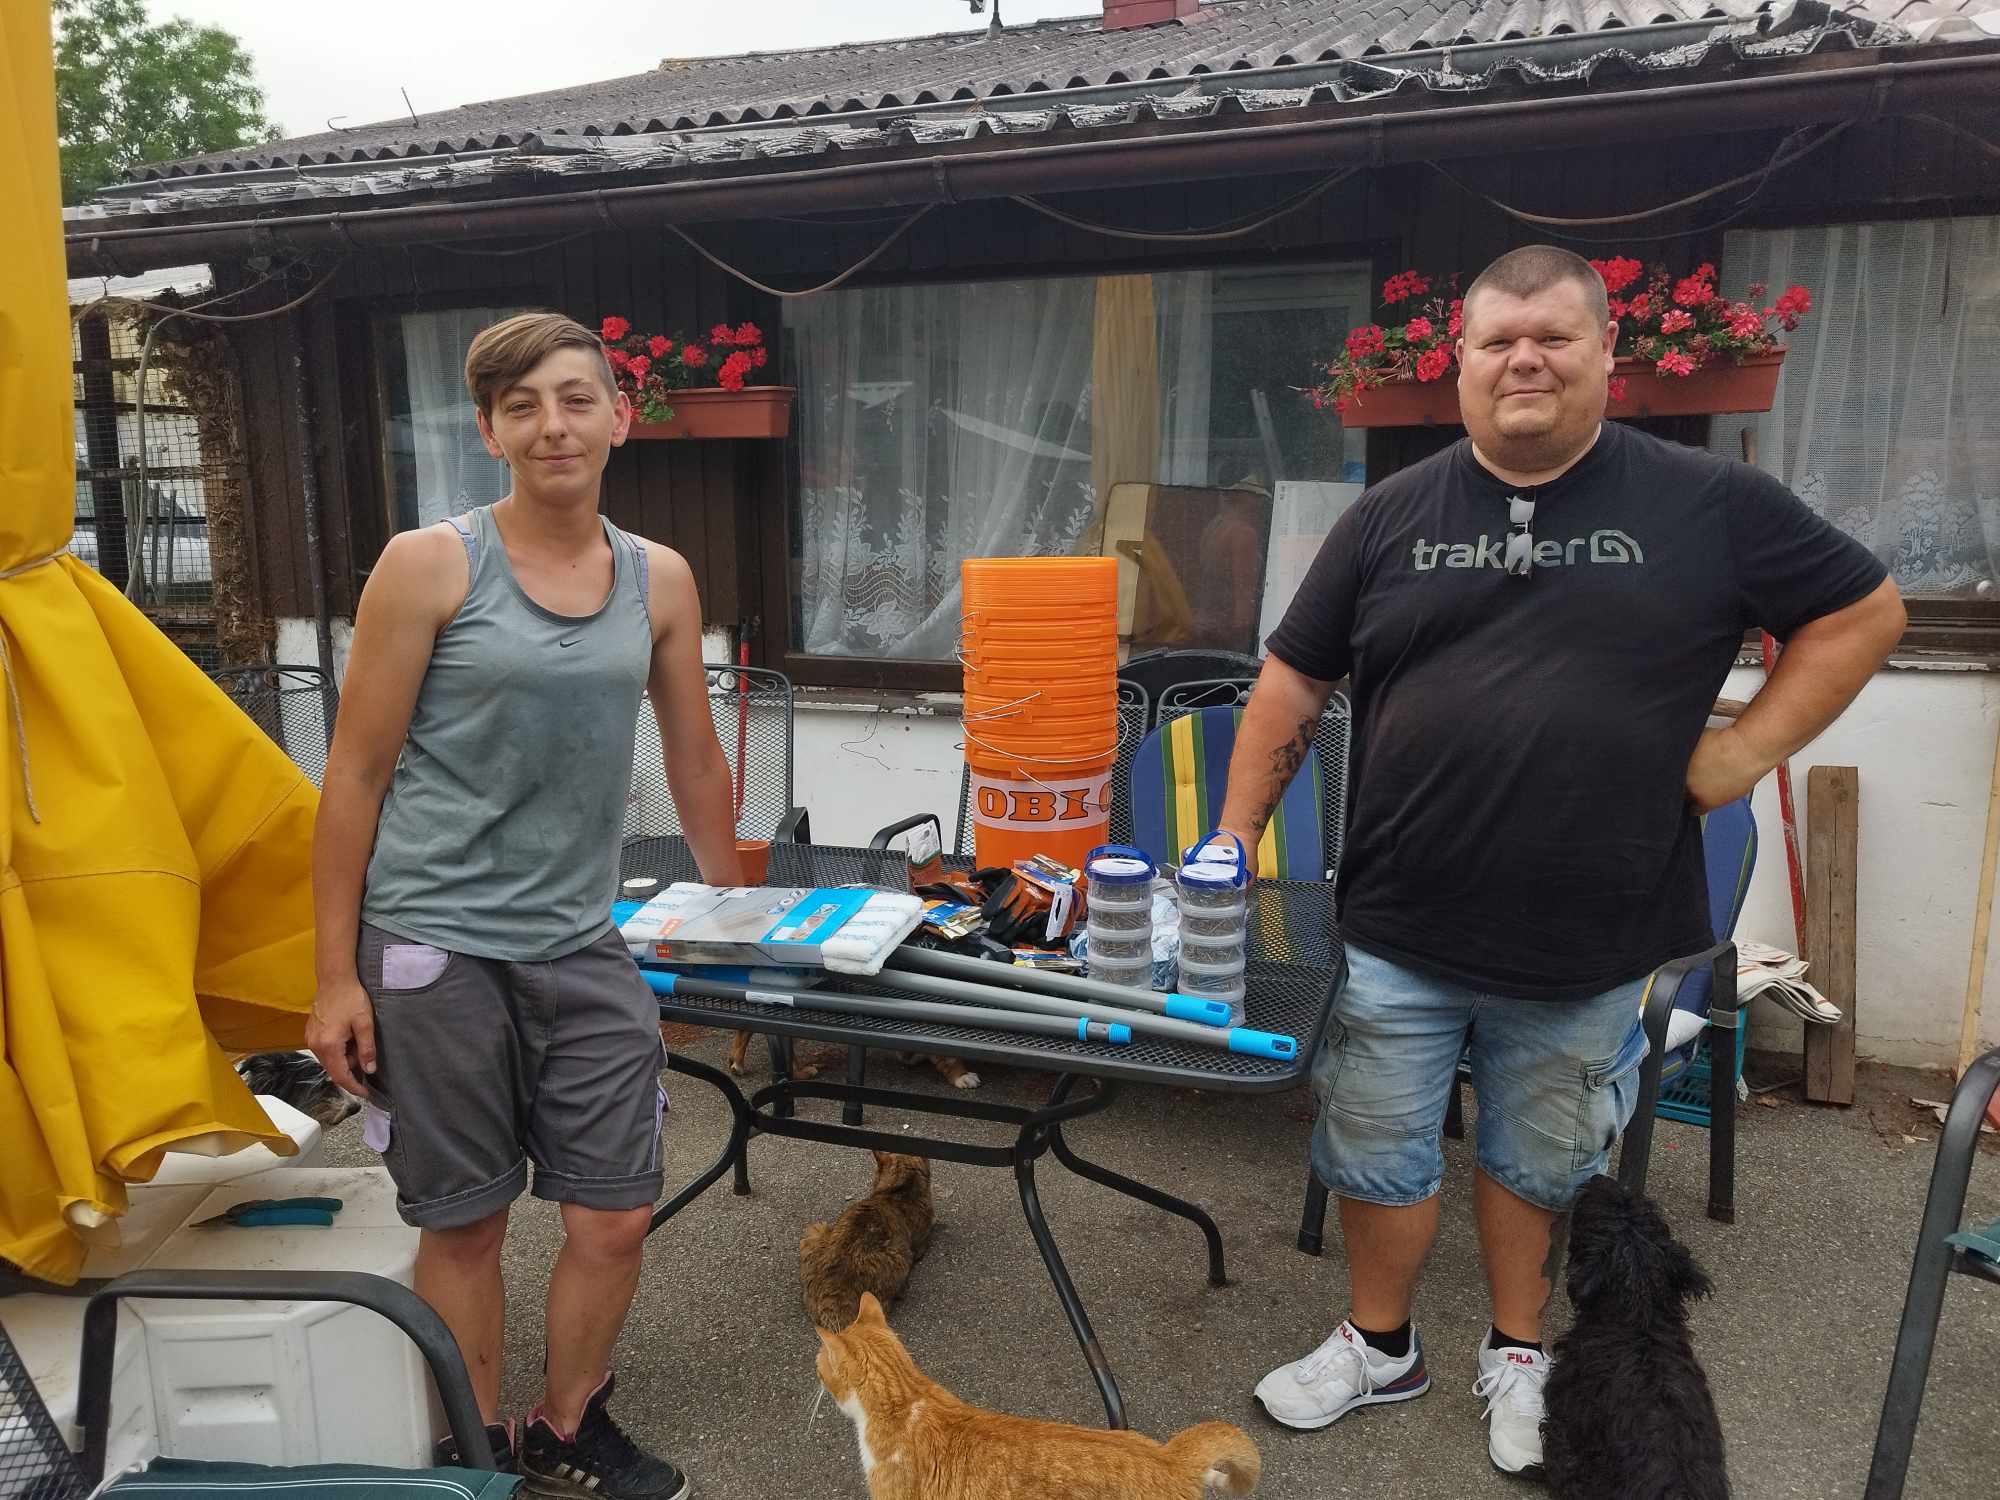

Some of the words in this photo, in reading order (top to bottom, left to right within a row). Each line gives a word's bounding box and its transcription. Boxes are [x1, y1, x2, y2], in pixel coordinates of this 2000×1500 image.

[1412, 534, 1586, 571] traker
[978, 786, 1090, 821] OBI
[1507, 1352, 1533, 1364] FILA
